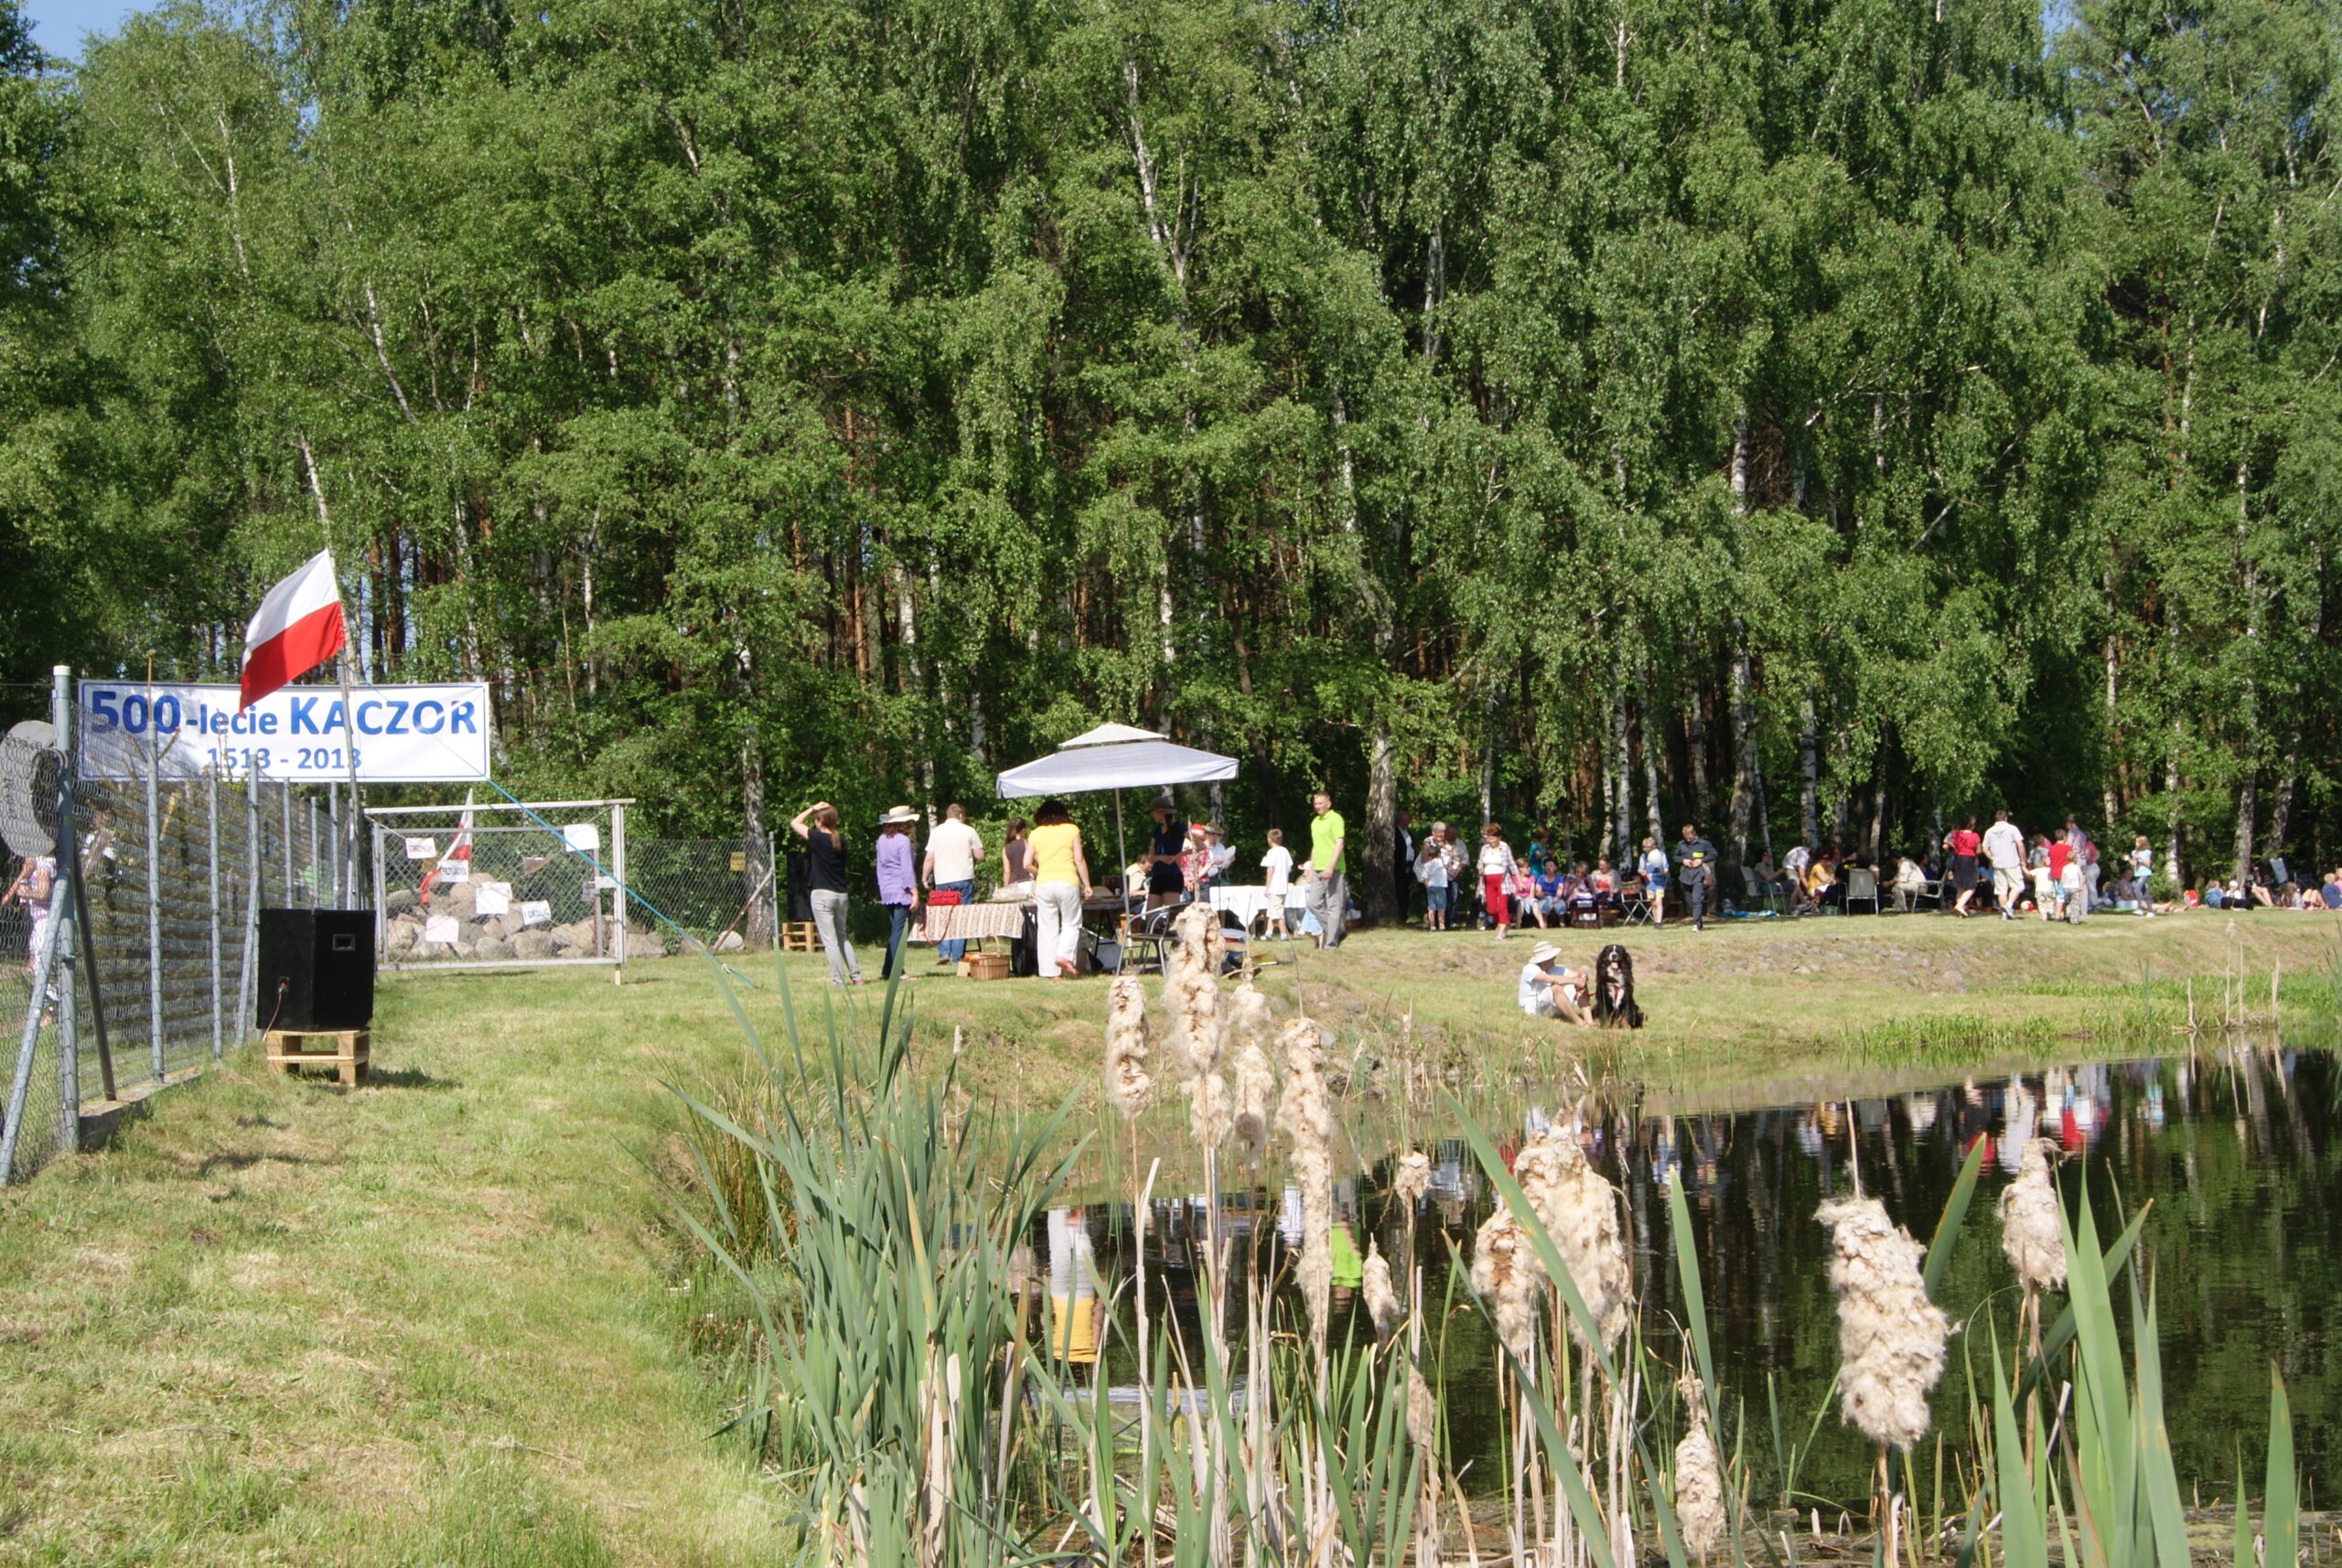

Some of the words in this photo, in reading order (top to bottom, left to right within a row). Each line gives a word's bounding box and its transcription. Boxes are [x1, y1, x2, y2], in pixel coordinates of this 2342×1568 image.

[91, 691, 278, 735] 500-lecie
[290, 696, 478, 735] KACZOR
[297, 747, 361, 769] 2013
